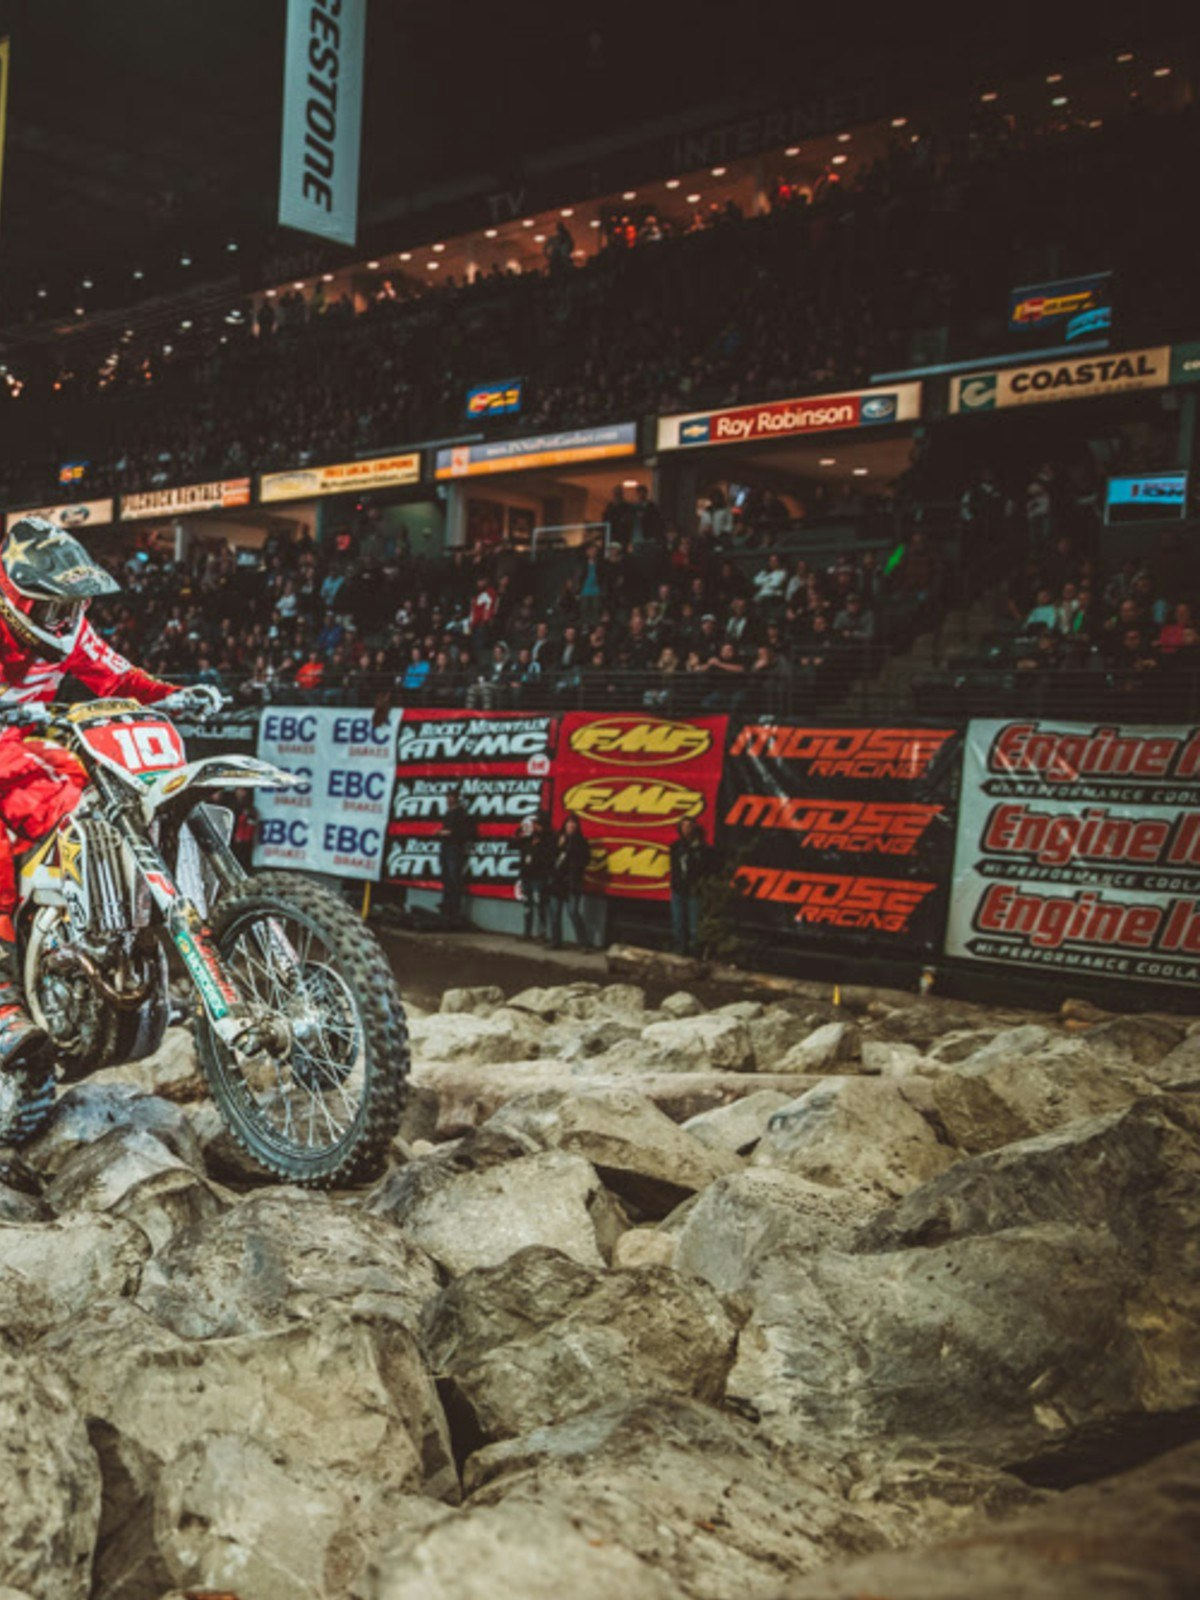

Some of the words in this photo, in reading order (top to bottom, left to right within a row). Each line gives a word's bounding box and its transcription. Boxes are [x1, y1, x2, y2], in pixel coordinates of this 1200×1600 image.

[1011, 356, 1156, 393] COASTAL
[717, 417, 754, 438] Roy
[757, 405, 852, 431] Robinson
[263, 715, 317, 743] EBC
[332, 717, 391, 745] EBC
[419, 722, 465, 737] ROCKY
[467, 718, 550, 735] MOUNTAIN
[572, 724, 709, 753] FMF
[729, 726, 957, 759] MOOSE
[113, 727, 179, 769] 10
[992, 723, 1179, 782] Engine
[808, 760, 926, 779] RACING
[327, 770, 385, 801] EBC
[413, 780, 459, 795] ROCKY
[461, 778, 542, 795] MOUNTAIN
[565, 783, 703, 815] FMF
[724, 795, 945, 835] MOOSE
[259, 819, 308, 847] EBC
[323, 823, 380, 858] EBC
[406, 839, 442, 854] ROCK
[801, 832, 917, 855] RACING
[985, 803, 1171, 866] Engine
[729, 865, 938, 913] MOOSE
[983, 864, 1137, 887] HI-PERFORMANCE
[797, 906, 907, 932] RACING
[979, 884, 1163, 947] Engine
[976, 942, 1130, 972] HI-PERFORMANCE
[186, 951, 227, 1014] MOTOREX
